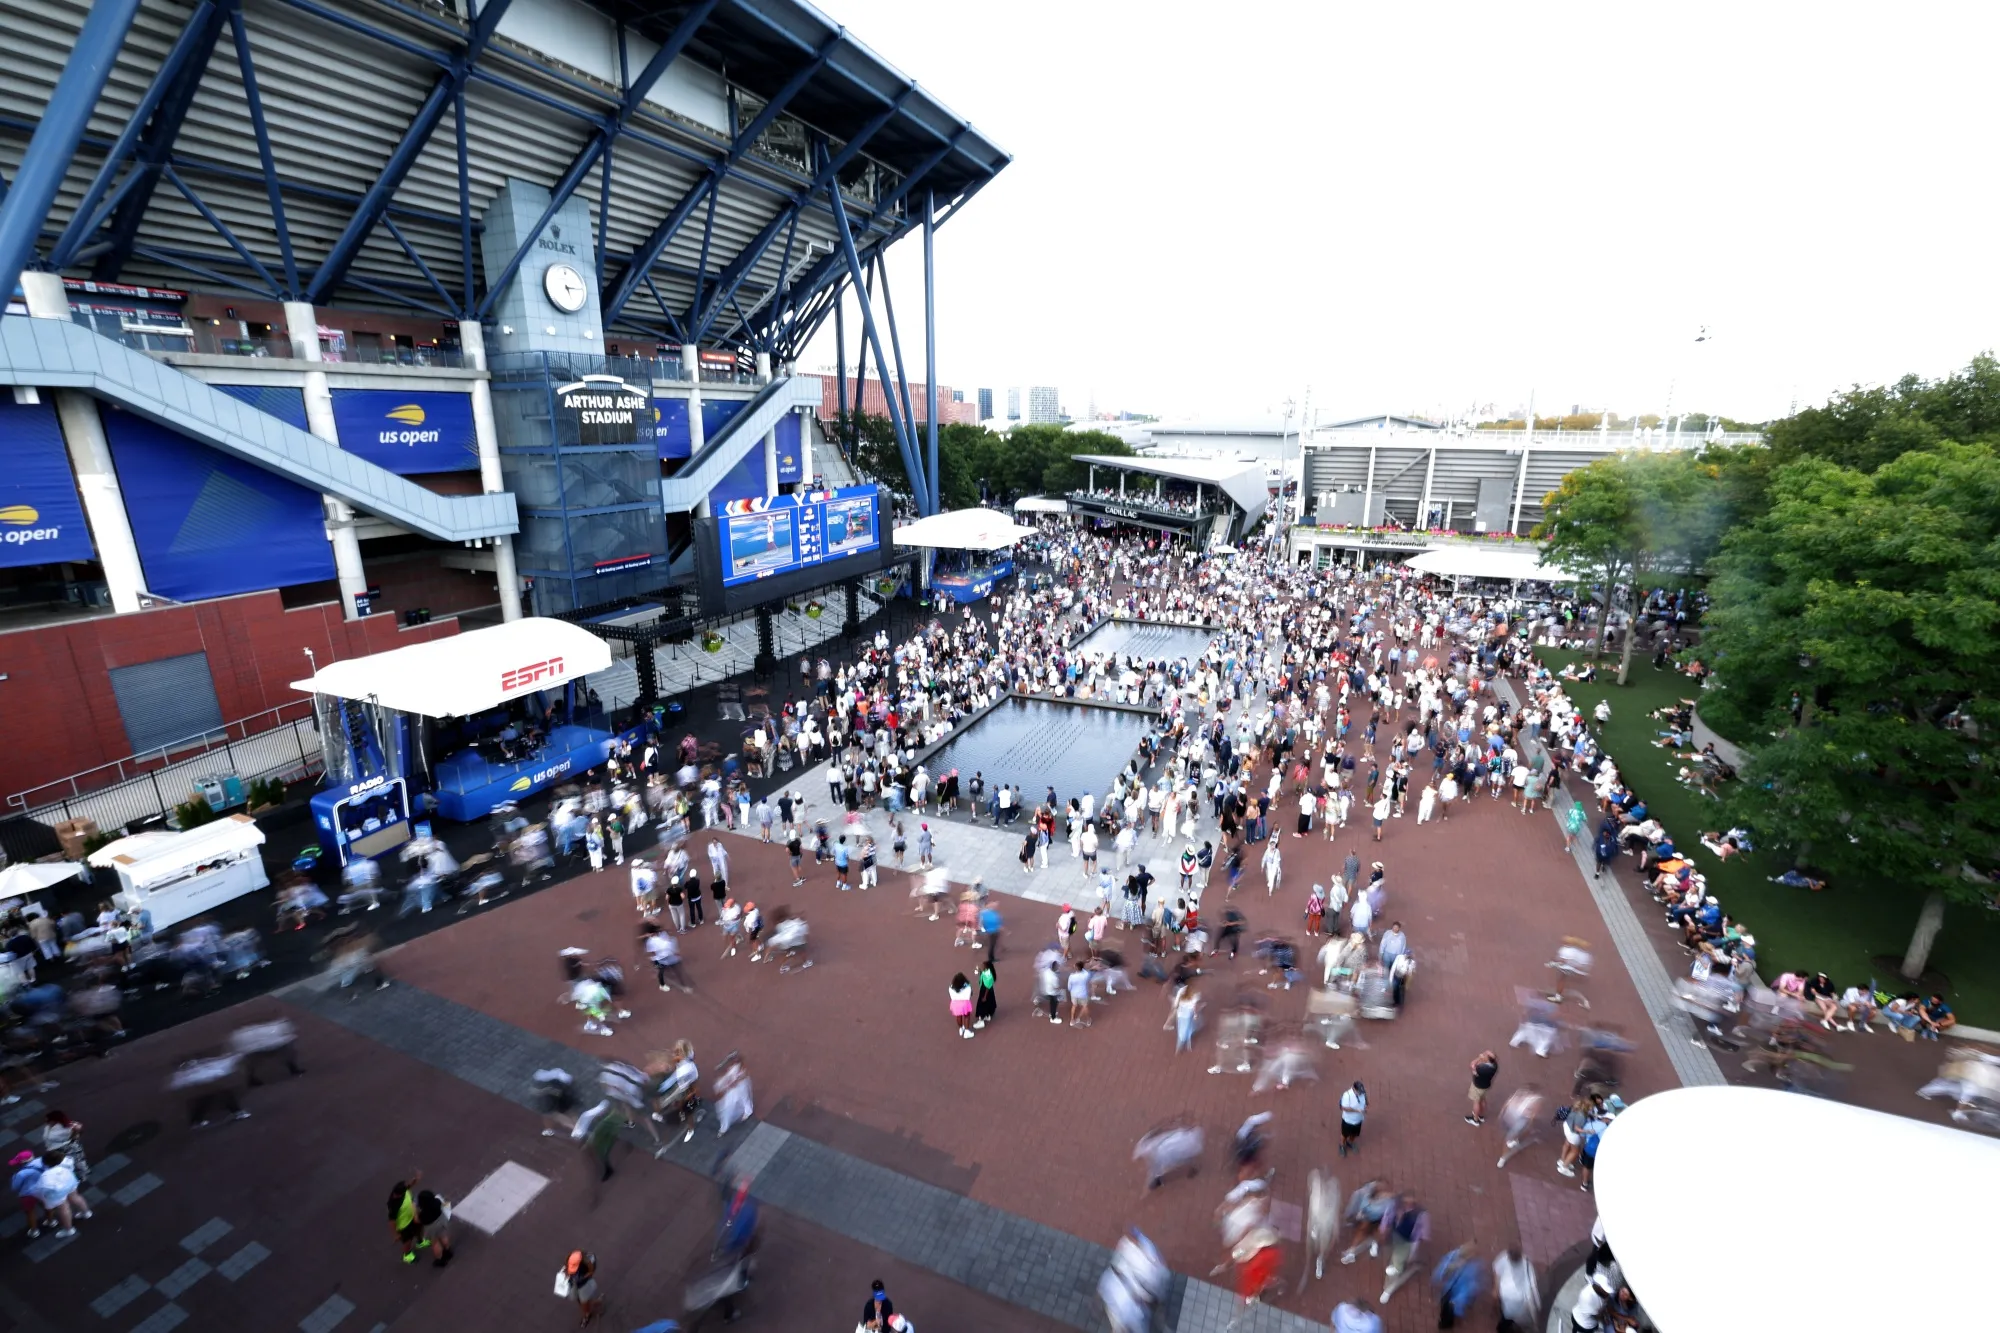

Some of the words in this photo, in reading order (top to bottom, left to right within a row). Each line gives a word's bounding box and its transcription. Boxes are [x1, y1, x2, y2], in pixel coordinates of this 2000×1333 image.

[538, 239, 575, 255] ROLEX
[564, 394, 613, 409] ARTHUR
[616, 395, 646, 409] ASHE
[581, 411, 633, 424] STADIUM
[380, 431, 398, 443] us
[400, 430, 439, 447] open
[1319, 491, 1337, 508] 11
[1104, 506, 1138, 519] CADILLAC
[5, 528, 58, 545] open
[1371, 539, 1391, 548] open
[501, 656, 564, 692] ESPN
[533, 773, 546, 784] us
[546, 759, 571, 779] open
[349, 775, 385, 796] RADIO
